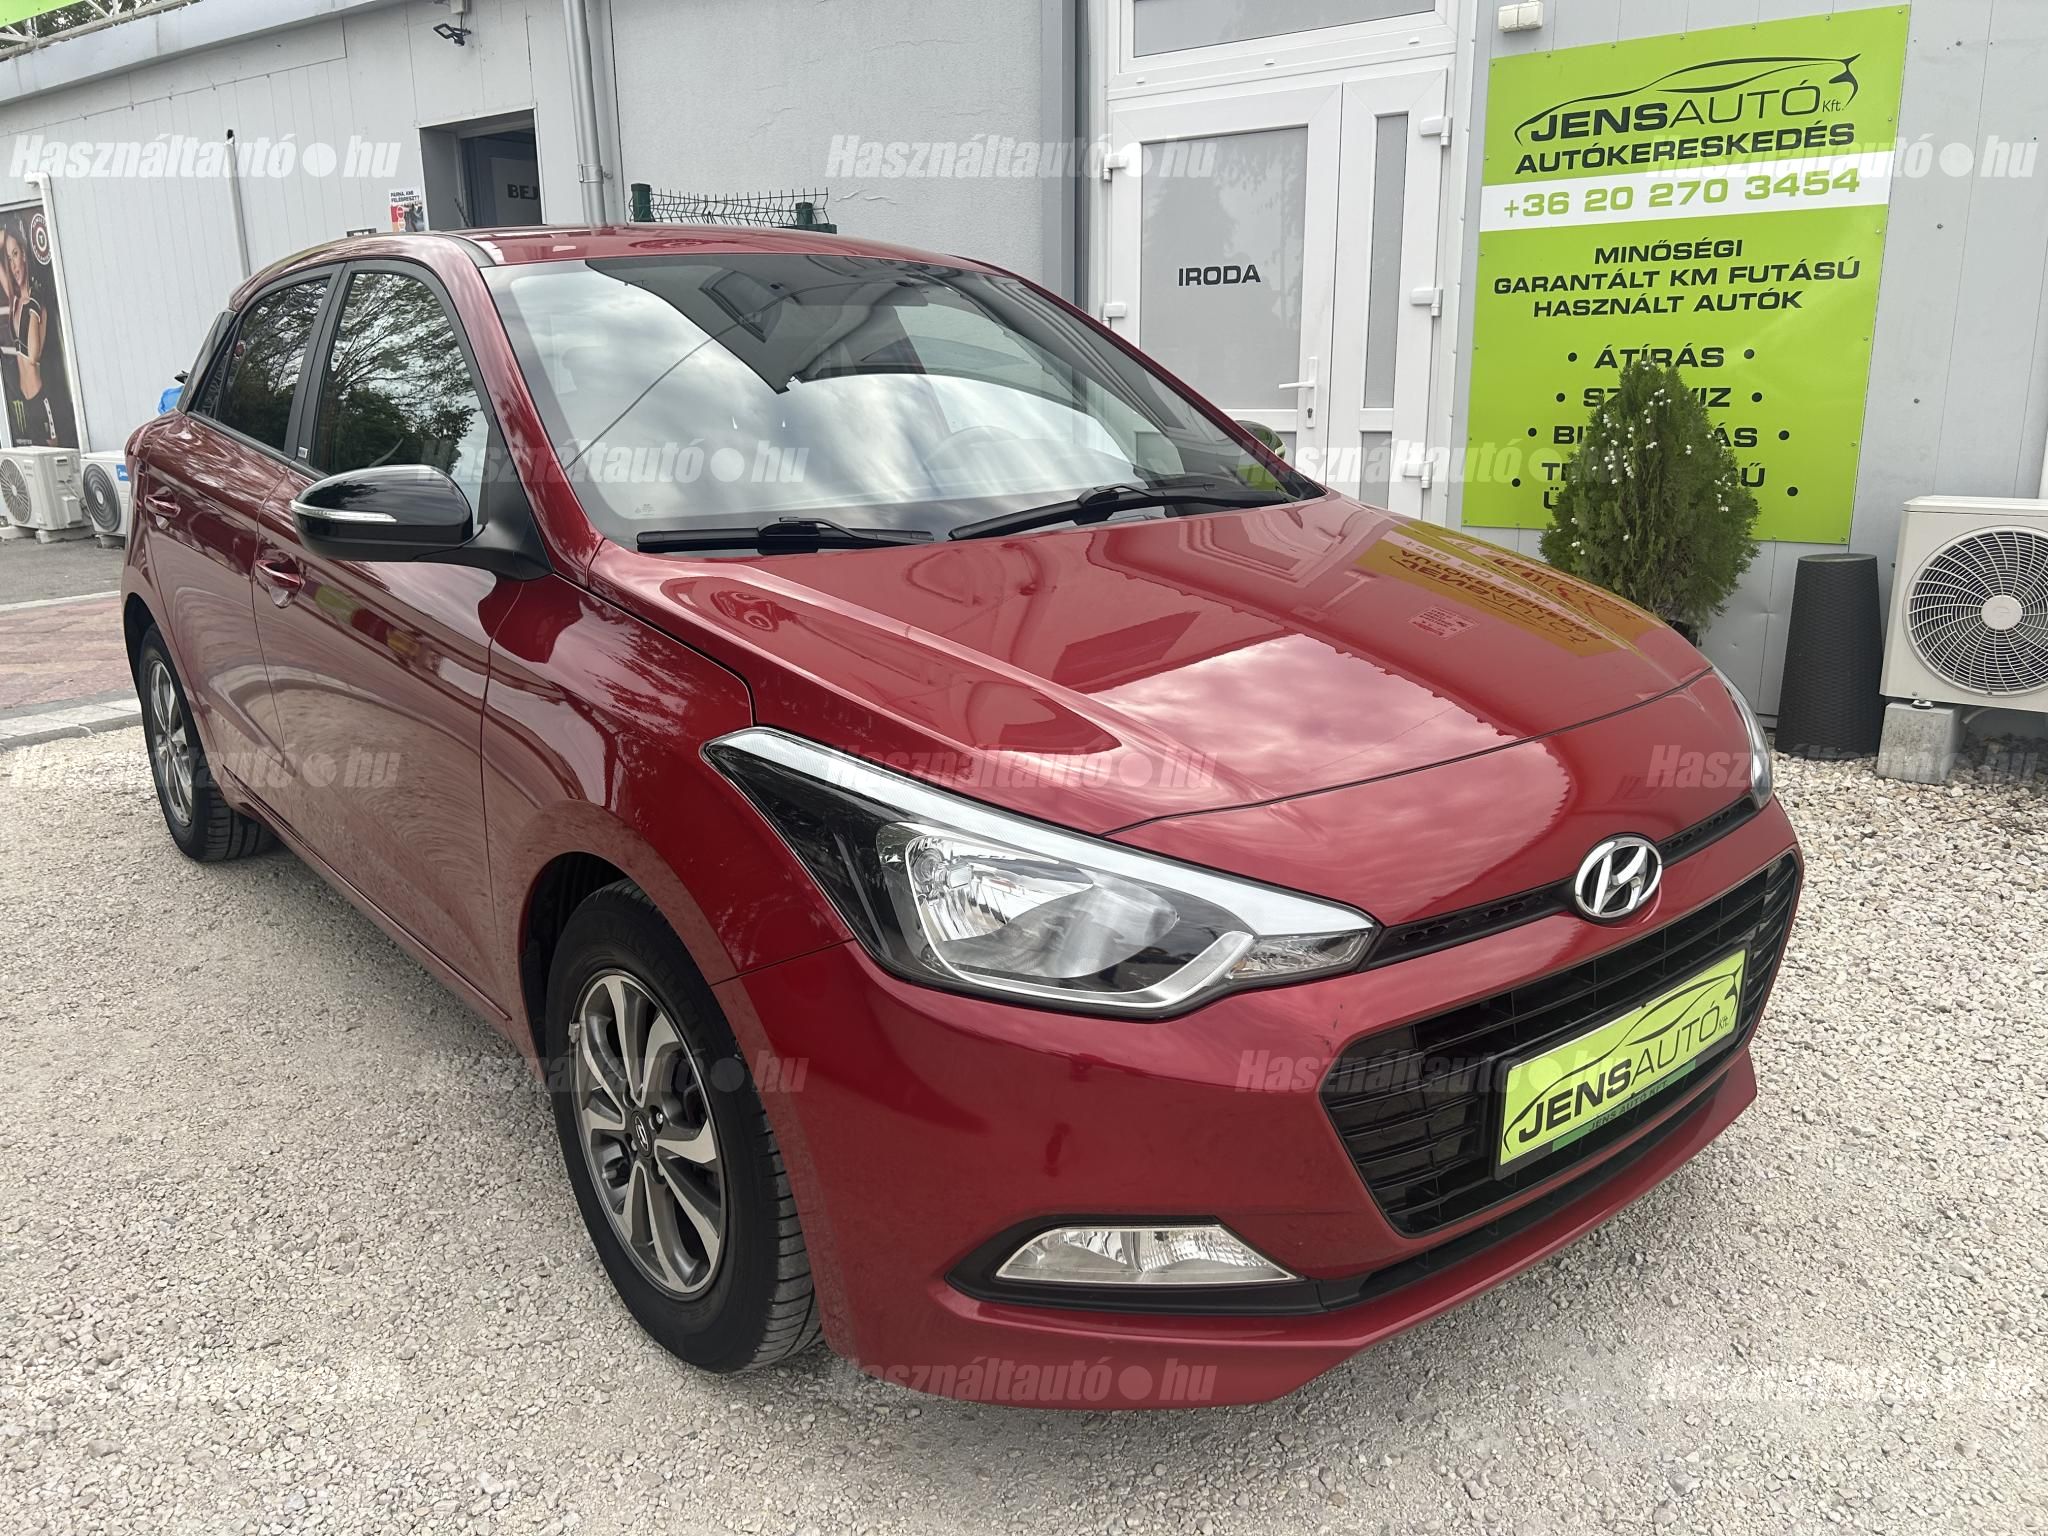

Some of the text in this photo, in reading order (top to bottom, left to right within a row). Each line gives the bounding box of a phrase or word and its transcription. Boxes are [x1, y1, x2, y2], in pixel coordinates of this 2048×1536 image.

[1515, 121, 1855, 175] AUTÓKERESKEDÉS
[1504, 168, 1860, 218] +36 20 270 3454
[1594, 238, 1743, 264] MINŐSÉGI
[1178, 264, 1262, 286] IRODA
[1494, 256, 1861, 294] GARANTÁLT KM FUTÁSÚ
[1534, 288, 1803, 318] HASZNÁLT AUTÓK
